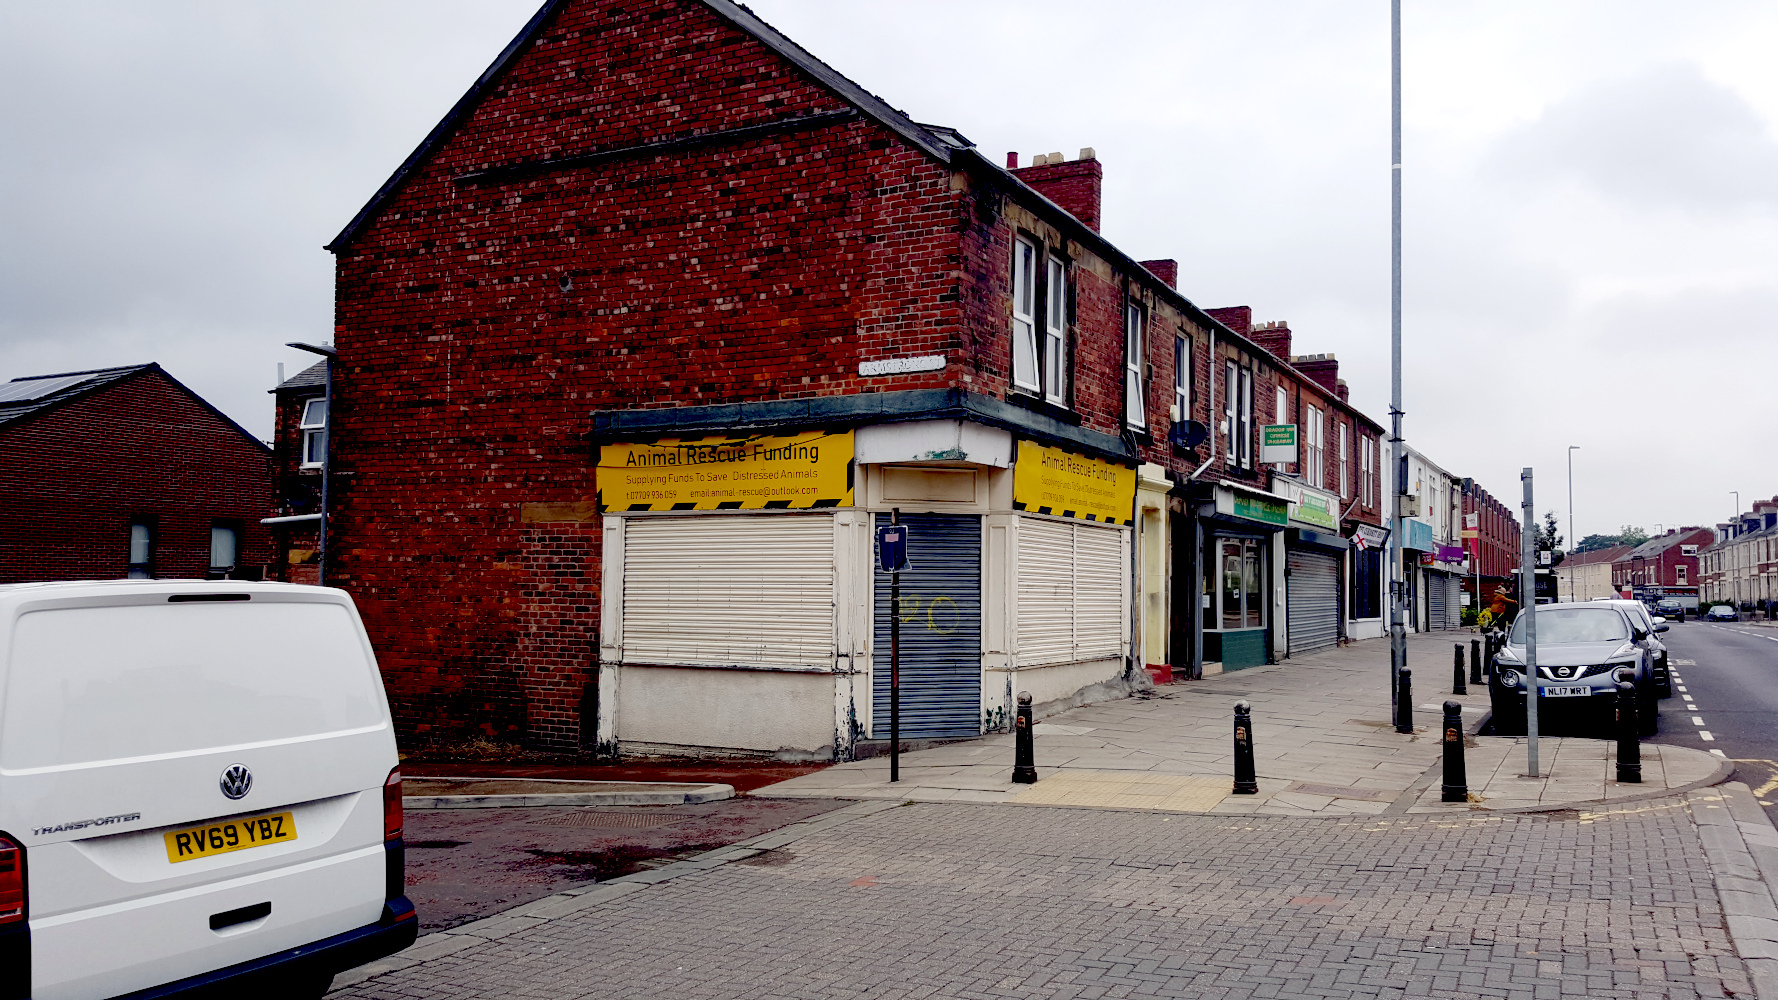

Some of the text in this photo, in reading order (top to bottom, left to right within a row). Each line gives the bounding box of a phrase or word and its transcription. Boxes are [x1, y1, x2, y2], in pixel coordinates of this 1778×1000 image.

[626, 443, 819, 467] Animal Rescue Funding
[626, 468, 818, 487] Supplying Funds To Save Distressed Animals
[1041, 450, 1117, 487] Animal Rescue Funding
[1548, 686, 1587, 696] NL17 WRT
[31, 811, 141, 836] TRANSPORTER
[175, 815, 287, 857] RV69 YBZ
